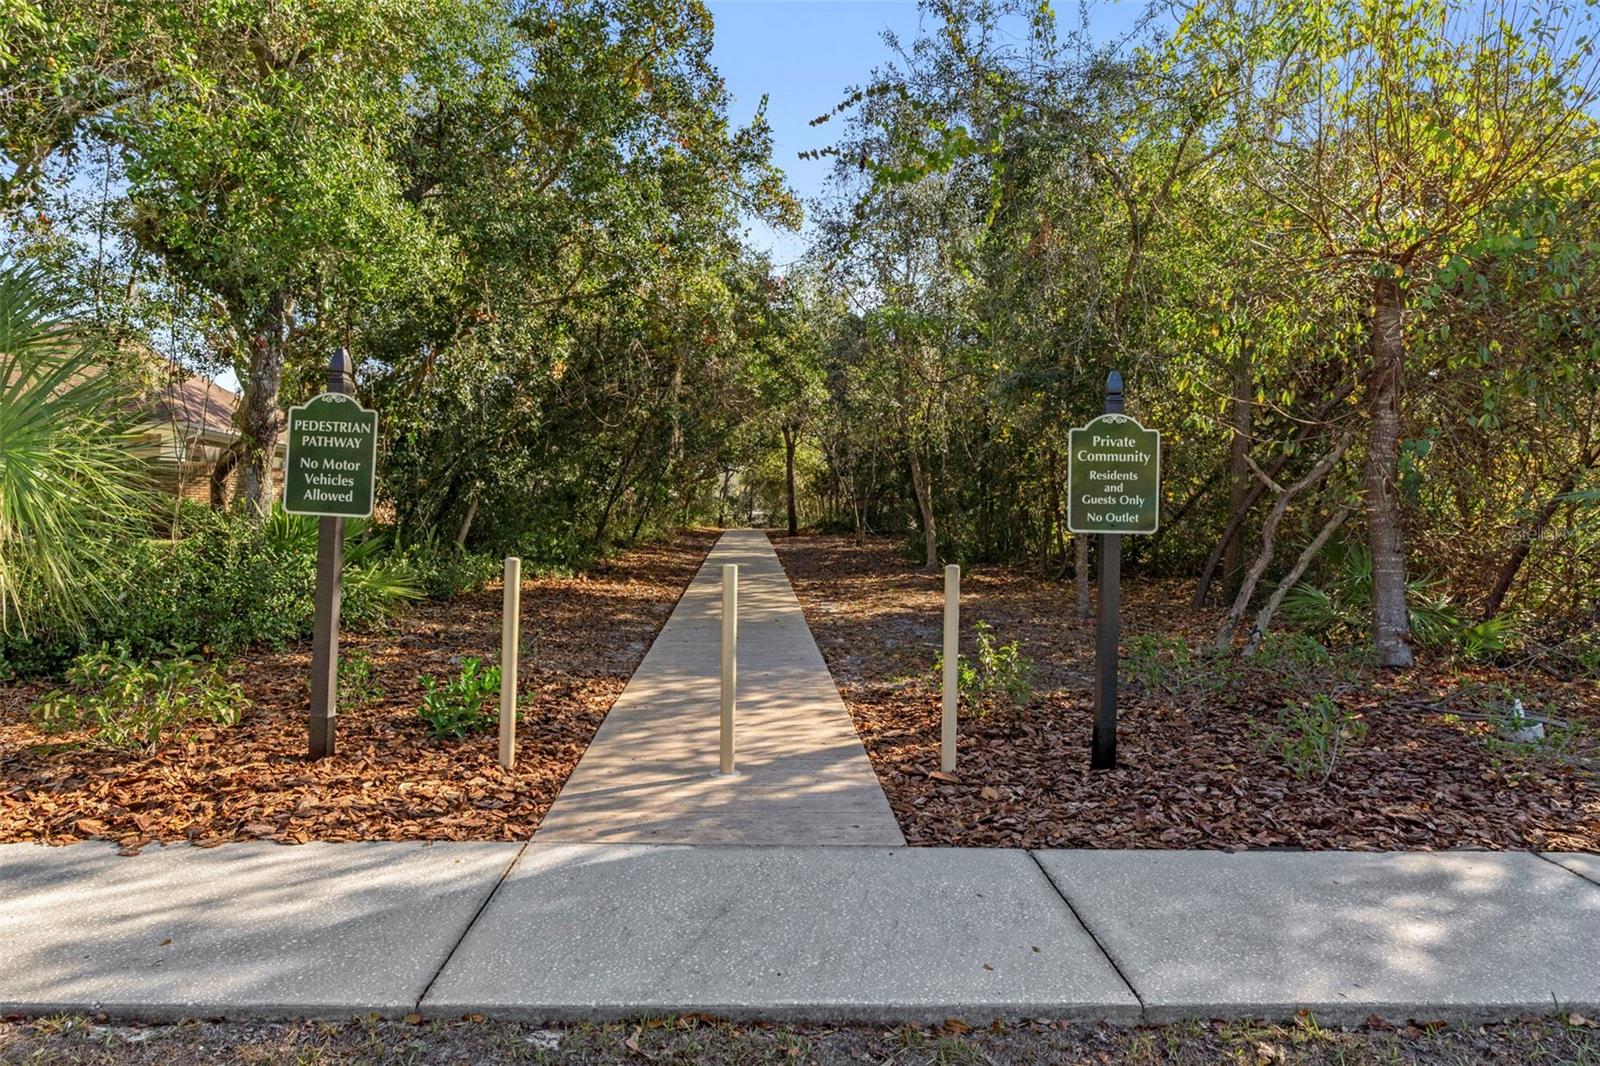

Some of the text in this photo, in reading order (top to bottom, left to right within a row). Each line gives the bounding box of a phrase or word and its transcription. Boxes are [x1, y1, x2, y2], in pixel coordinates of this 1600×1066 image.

[294, 420, 371, 434] PEDESTRIAN
[302, 435, 363, 449] PATHWAY
[1092, 435, 1136, 447] Private
[300, 457, 361, 471] No Motor
[1077, 449, 1151, 466] Community
[304, 473, 355, 486] Vehicles
[1089, 470, 1138, 481] Residents
[1104, 482, 1124, 493] and
[303, 488, 353, 502] Allowed
[1081, 494, 1146, 508] Guests Only
[1086, 512, 1139, 523] No Outlet
